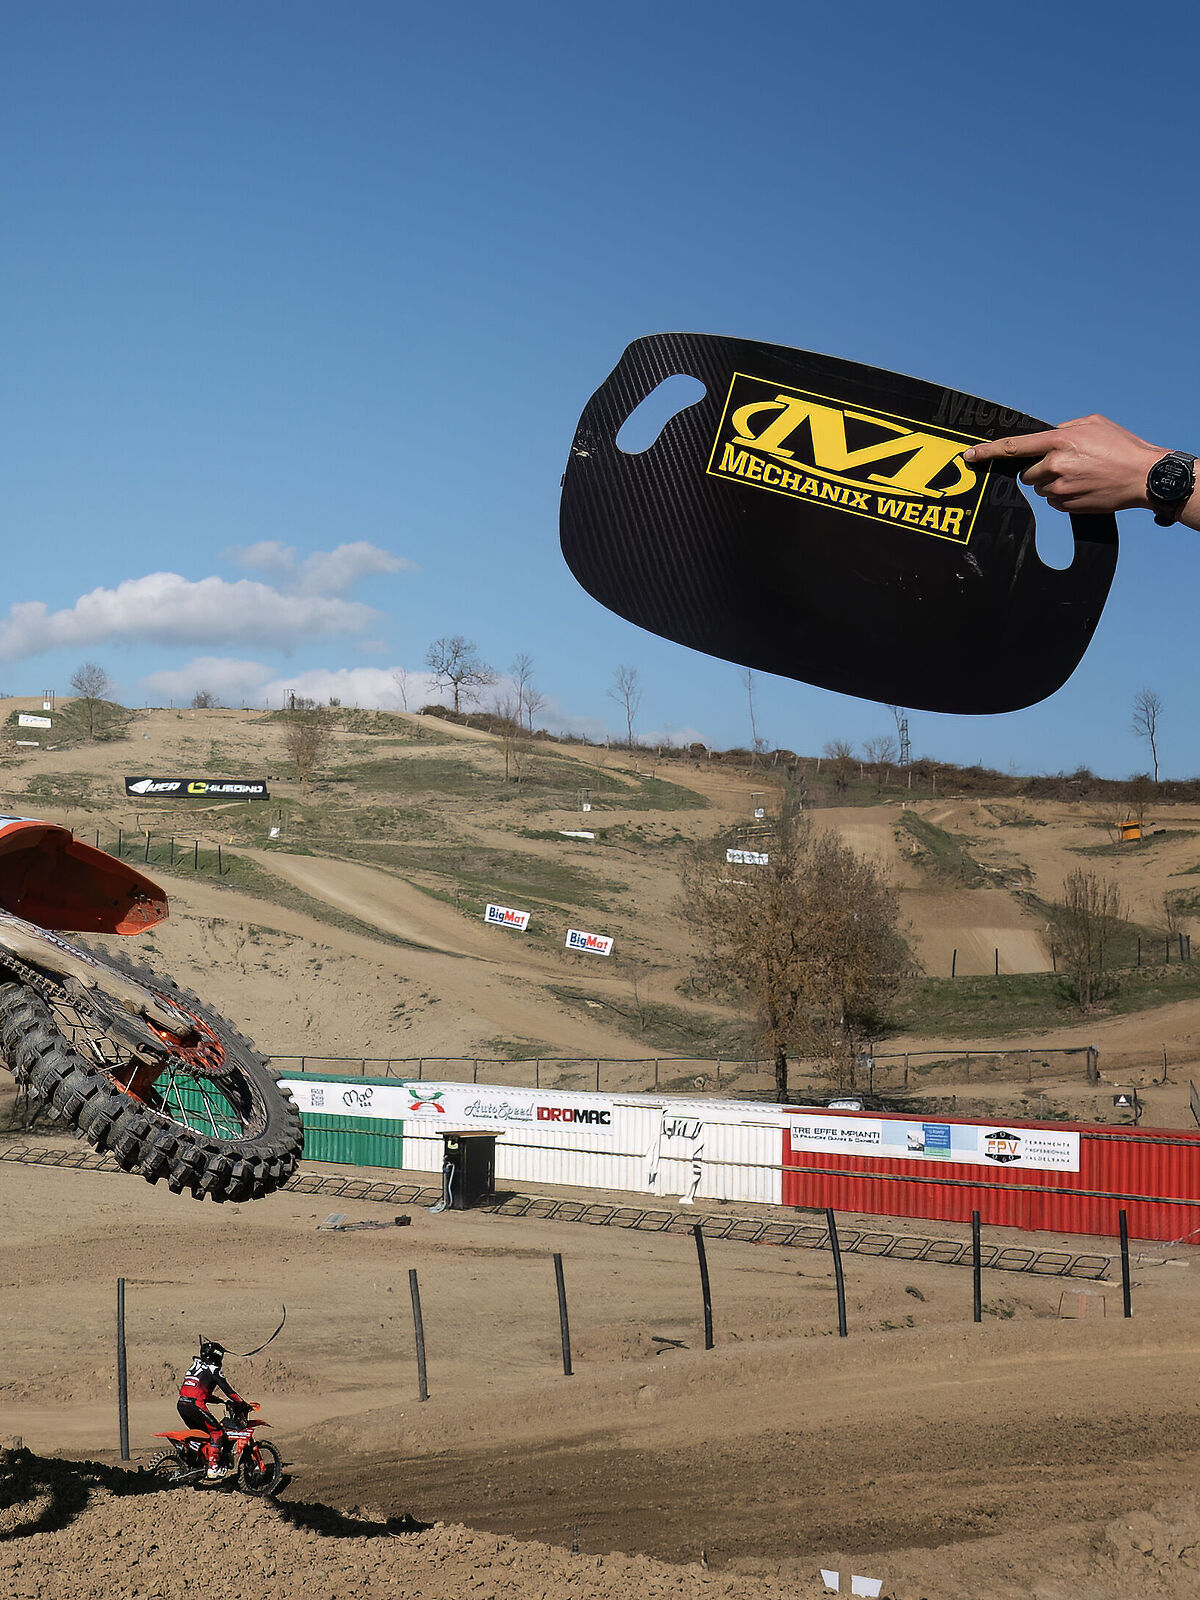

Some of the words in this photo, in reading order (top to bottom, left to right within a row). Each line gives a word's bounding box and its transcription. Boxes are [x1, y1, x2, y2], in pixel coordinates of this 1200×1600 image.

[718, 442, 870, 511] MECHANIX
[876, 496, 966, 535] WEAR
[489, 907, 525, 924] BigMat
[570, 932, 608, 950] BigMat
[537, 1106, 611, 1125] IDROMAC
[793, 1126, 811, 1134] TRE
[814, 1127, 837, 1136] EFFE
[840, 1129, 880, 1139] IMPIANTI
[987, 1140, 1018, 1154] FPV
[1025, 1139, 1070, 1147] FERRAMENTA
